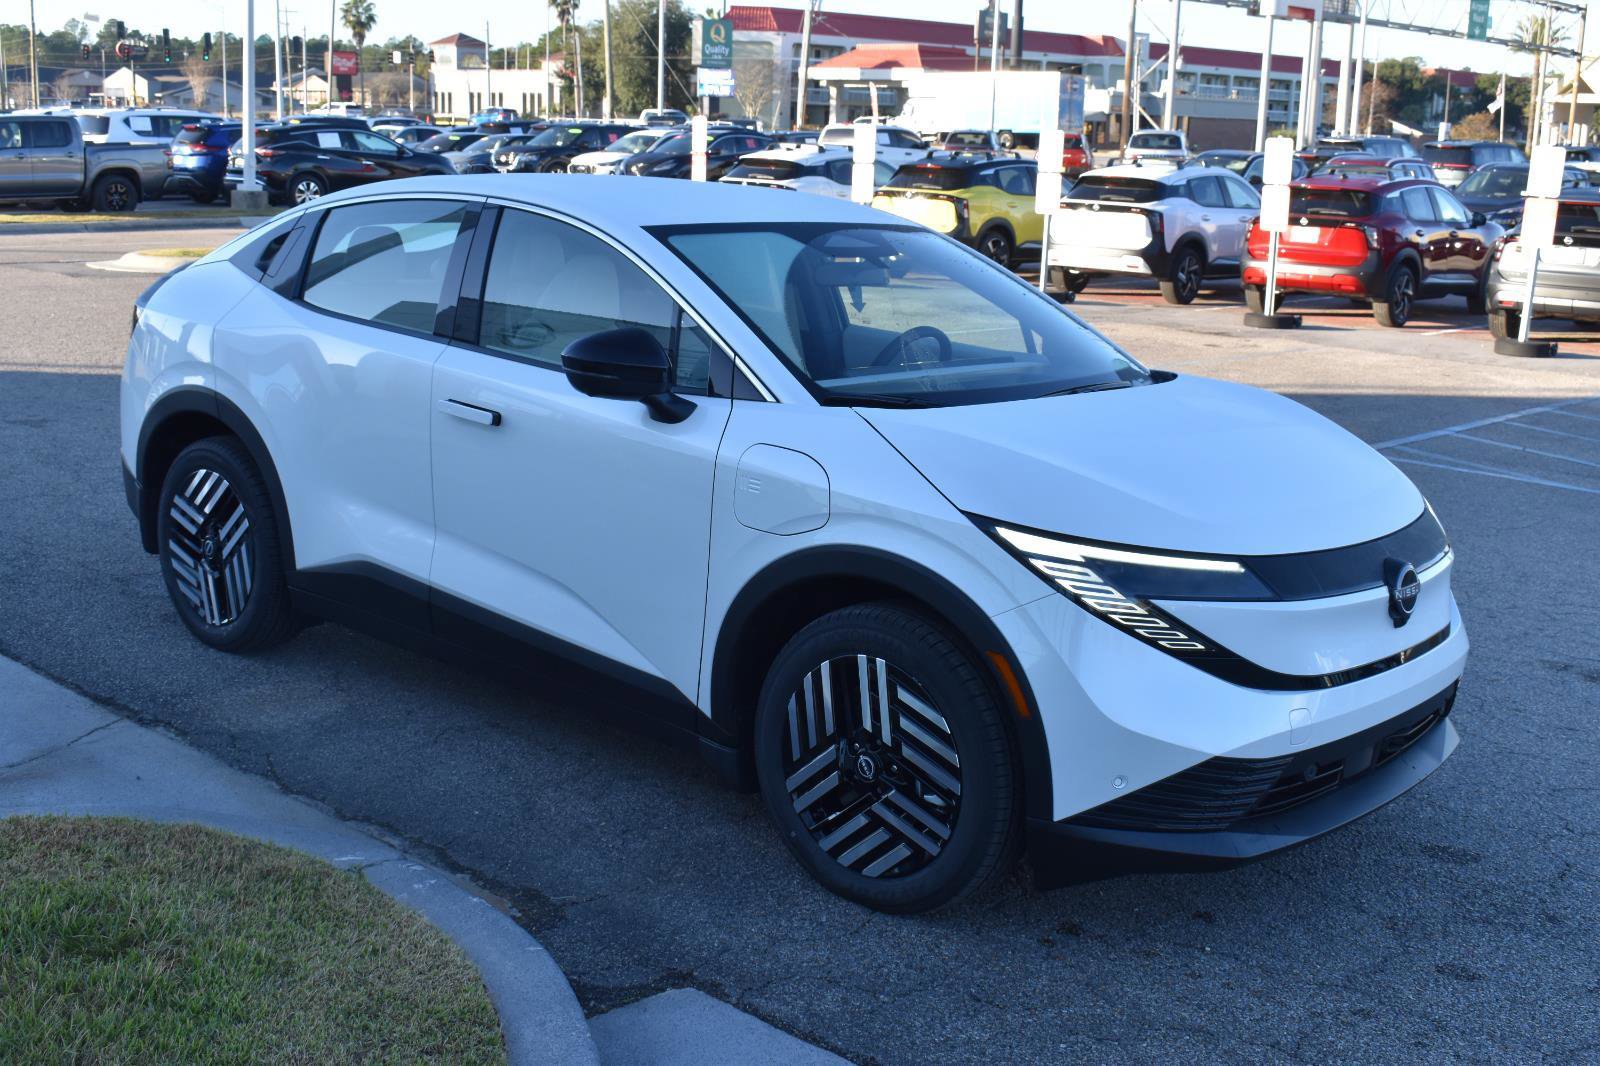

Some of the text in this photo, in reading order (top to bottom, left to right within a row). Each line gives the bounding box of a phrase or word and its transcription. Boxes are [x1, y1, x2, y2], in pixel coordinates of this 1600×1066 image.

[710, 23, 726, 43] Q
[704, 43, 730, 56] Quality
[1395, 583, 1420, 601] NISS
